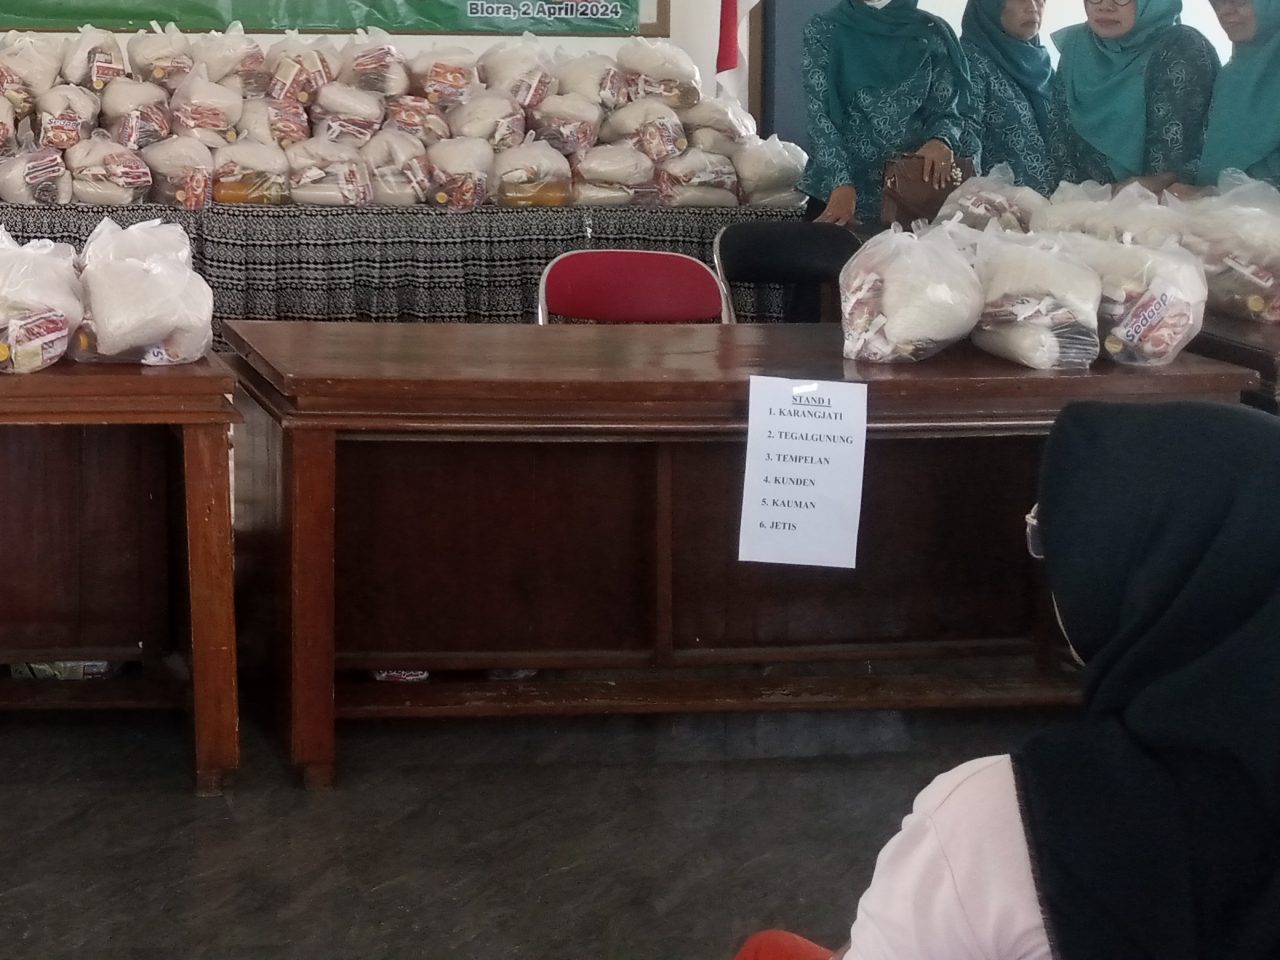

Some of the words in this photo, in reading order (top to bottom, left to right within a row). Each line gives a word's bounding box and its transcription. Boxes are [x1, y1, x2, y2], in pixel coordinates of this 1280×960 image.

[468, 2, 518, 20] Blora,
[521, 2, 532, 17] 2
[534, 2, 575, 19] April
[576, 2, 621, 18] 2024
[1125, 292, 1168, 342] Sedaap
[792, 395, 825, 406] STAND
[826, 398, 832, 406] 1
[769, 407, 776, 416] 1.
[778, 407, 843, 421] KARANGJATI
[767, 430, 775, 439] 2.
[778, 431, 854, 444] TEGALGUNUNG
[765, 453, 773, 462] 3.
[776, 453, 830, 465] TEMPELAN
[763, 475, 770, 484] 4.
[774, 476, 815, 487] KUNDEN
[761, 498, 769, 507] 5.
[772, 499, 816, 510] KAUMAN
[759, 520, 766, 529] 6.
[769, 522, 797, 531] JETIS
